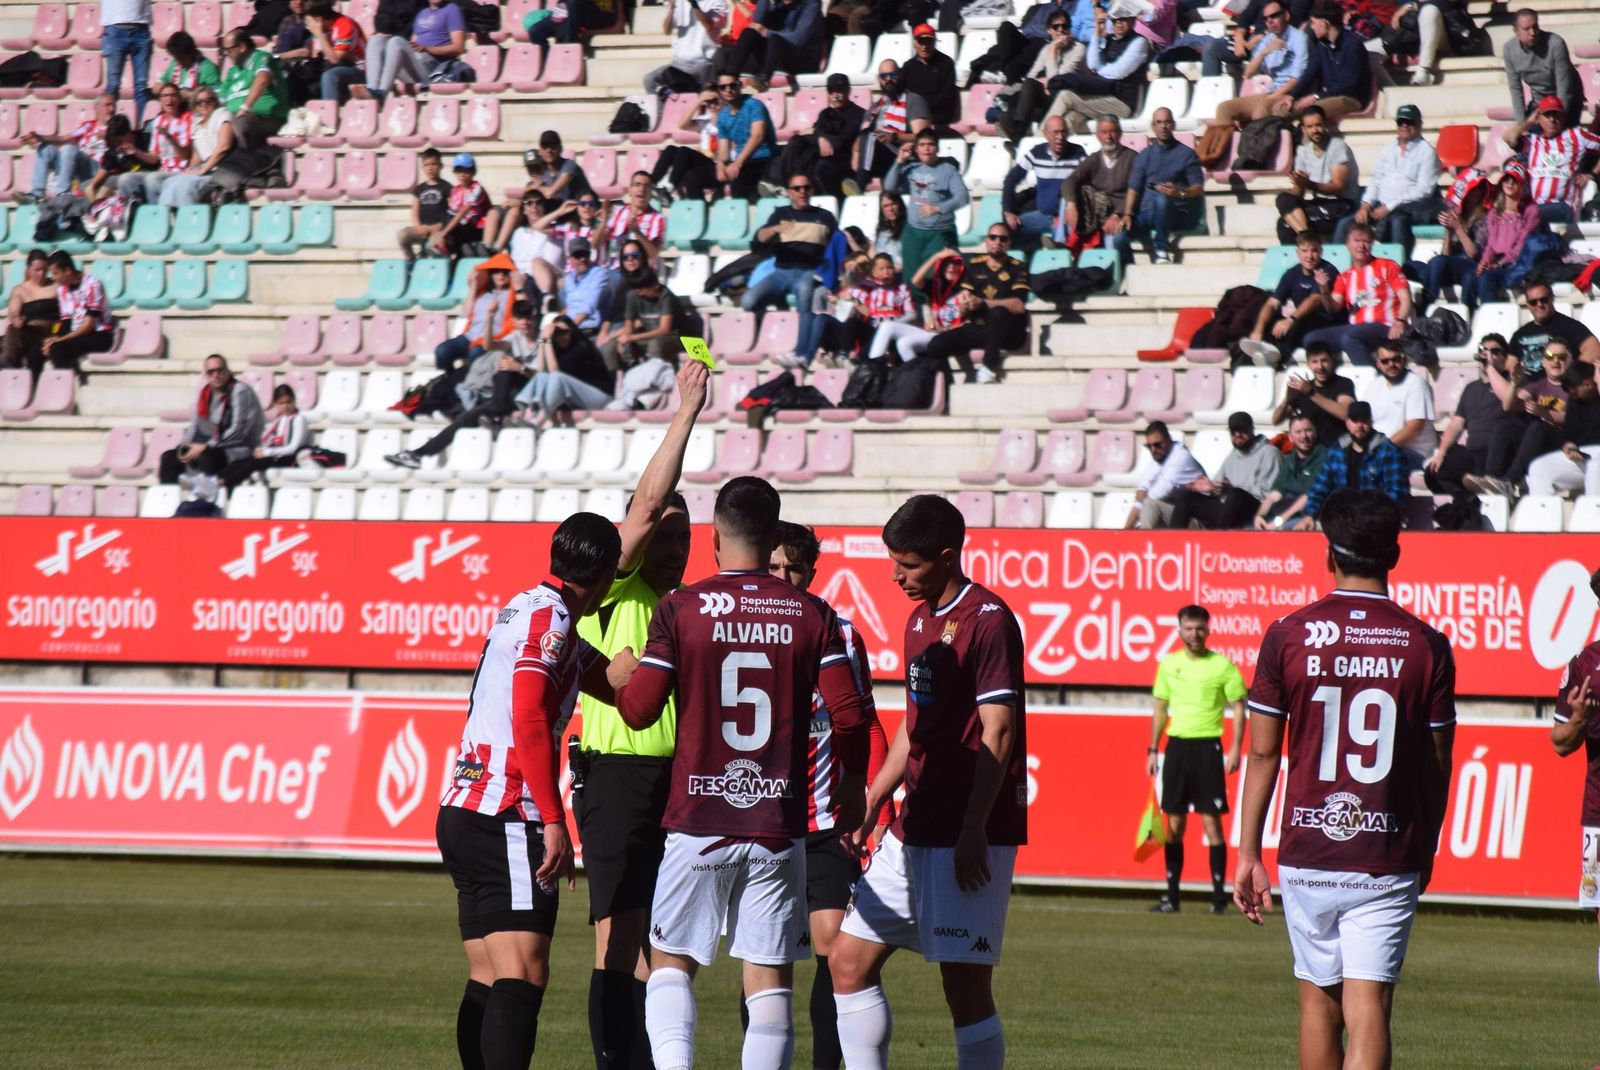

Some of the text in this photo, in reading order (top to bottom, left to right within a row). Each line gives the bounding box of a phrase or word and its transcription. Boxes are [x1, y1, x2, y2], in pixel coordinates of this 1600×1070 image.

[104, 548, 131, 574] sgc
[292, 551, 318, 577] sgc
[462, 553, 490, 580] sgc
[960, 534, 1191, 591] ínica Dental
[1220, 554, 1282, 574] Donantes
[1285, 555, 1303, 575] de
[740, 596, 802, 608] Deputación
[1201, 584, 1247, 609] Sangre
[1272, 586, 1306, 606] Local
[1388, 577, 1524, 617] PINTERÍA
[7, 588, 157, 639] sangregorio
[192, 591, 345, 643] sangregorio
[360, 594, 502, 647] sangregori
[740, 605, 802, 617] Pontevedra
[712, 621, 793, 645] ALVARO
[1014, 594, 1180, 675] Zález
[1209, 614, 1262, 635] AMORA
[1345, 626, 1410, 638] Deputación
[1484, 617, 1523, 650] DE
[1345, 635, 1410, 647] Pontevedra
[1307, 655, 1405, 679] B. GARAY
[721, 651, 773, 751] 5
[1311, 685, 1397, 784] 19
[55, 741, 331, 820] INNOVA Chef
[1291, 807, 1399, 833] PESCAMAR
